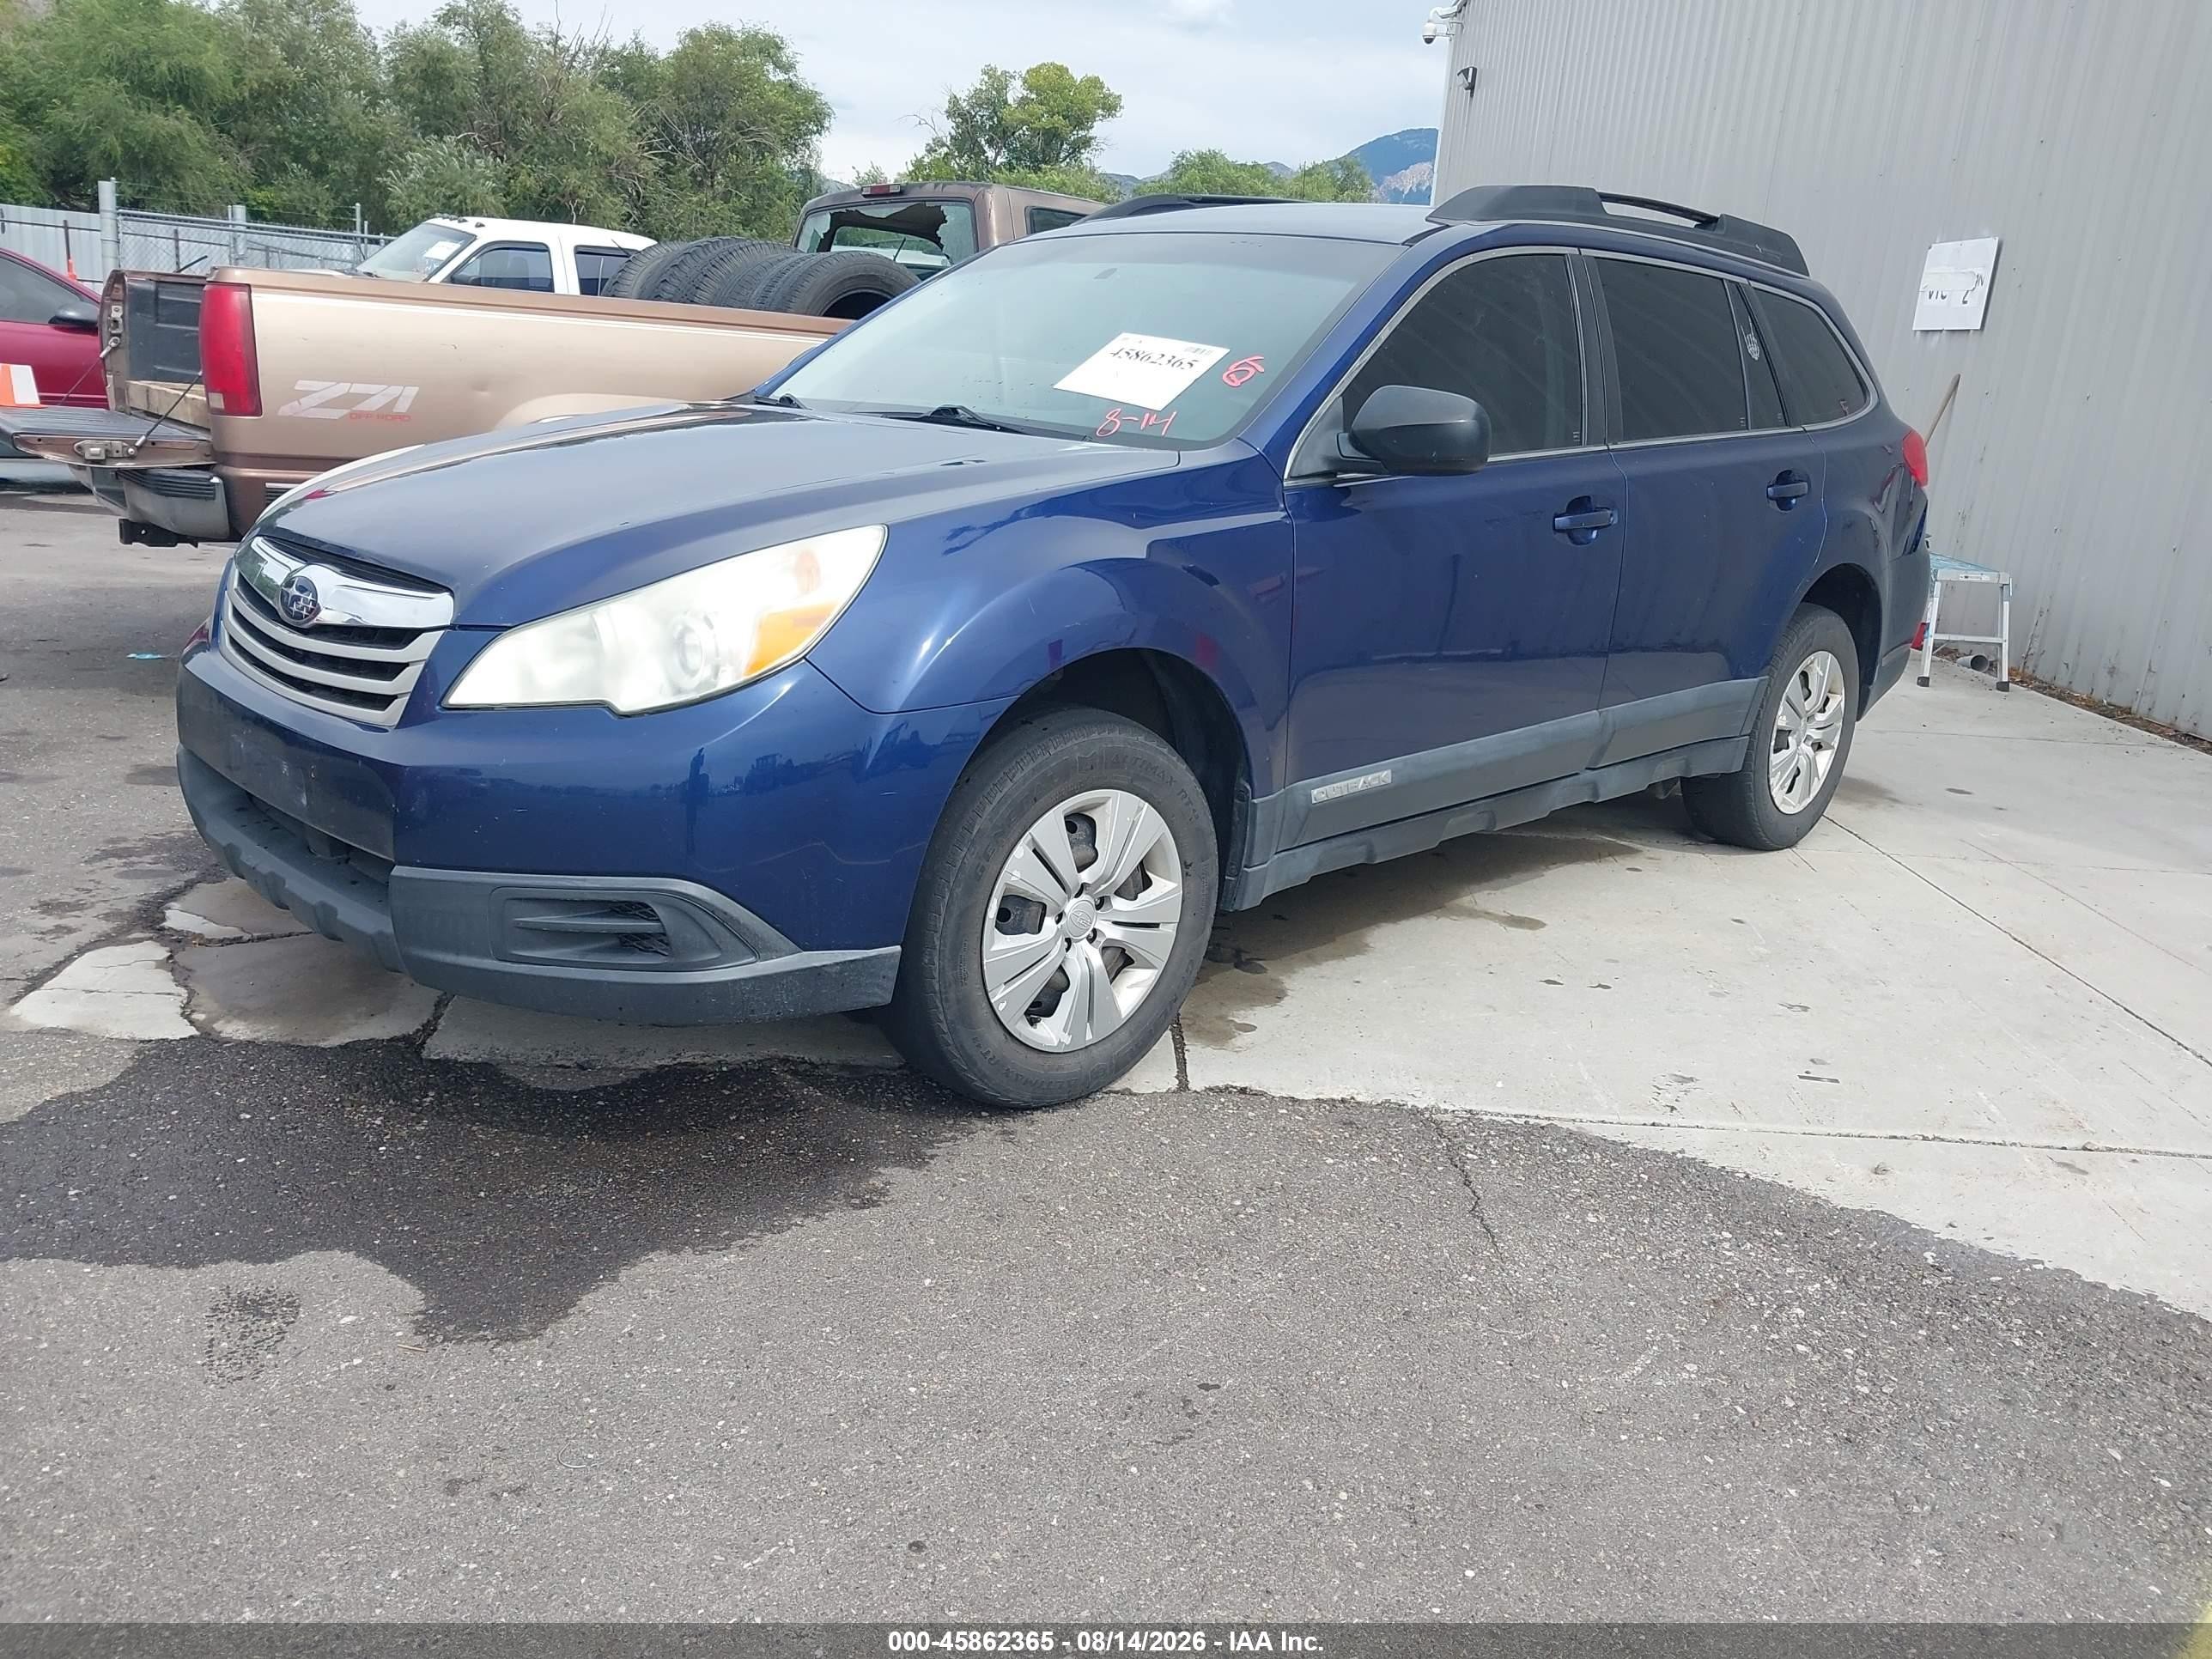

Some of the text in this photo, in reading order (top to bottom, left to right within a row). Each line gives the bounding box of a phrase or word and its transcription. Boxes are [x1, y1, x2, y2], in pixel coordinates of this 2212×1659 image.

[1109, 347, 1203, 370] 45862365
[277, 380, 420, 419] Z71
[1096, 409, 1177, 438] 8-14
